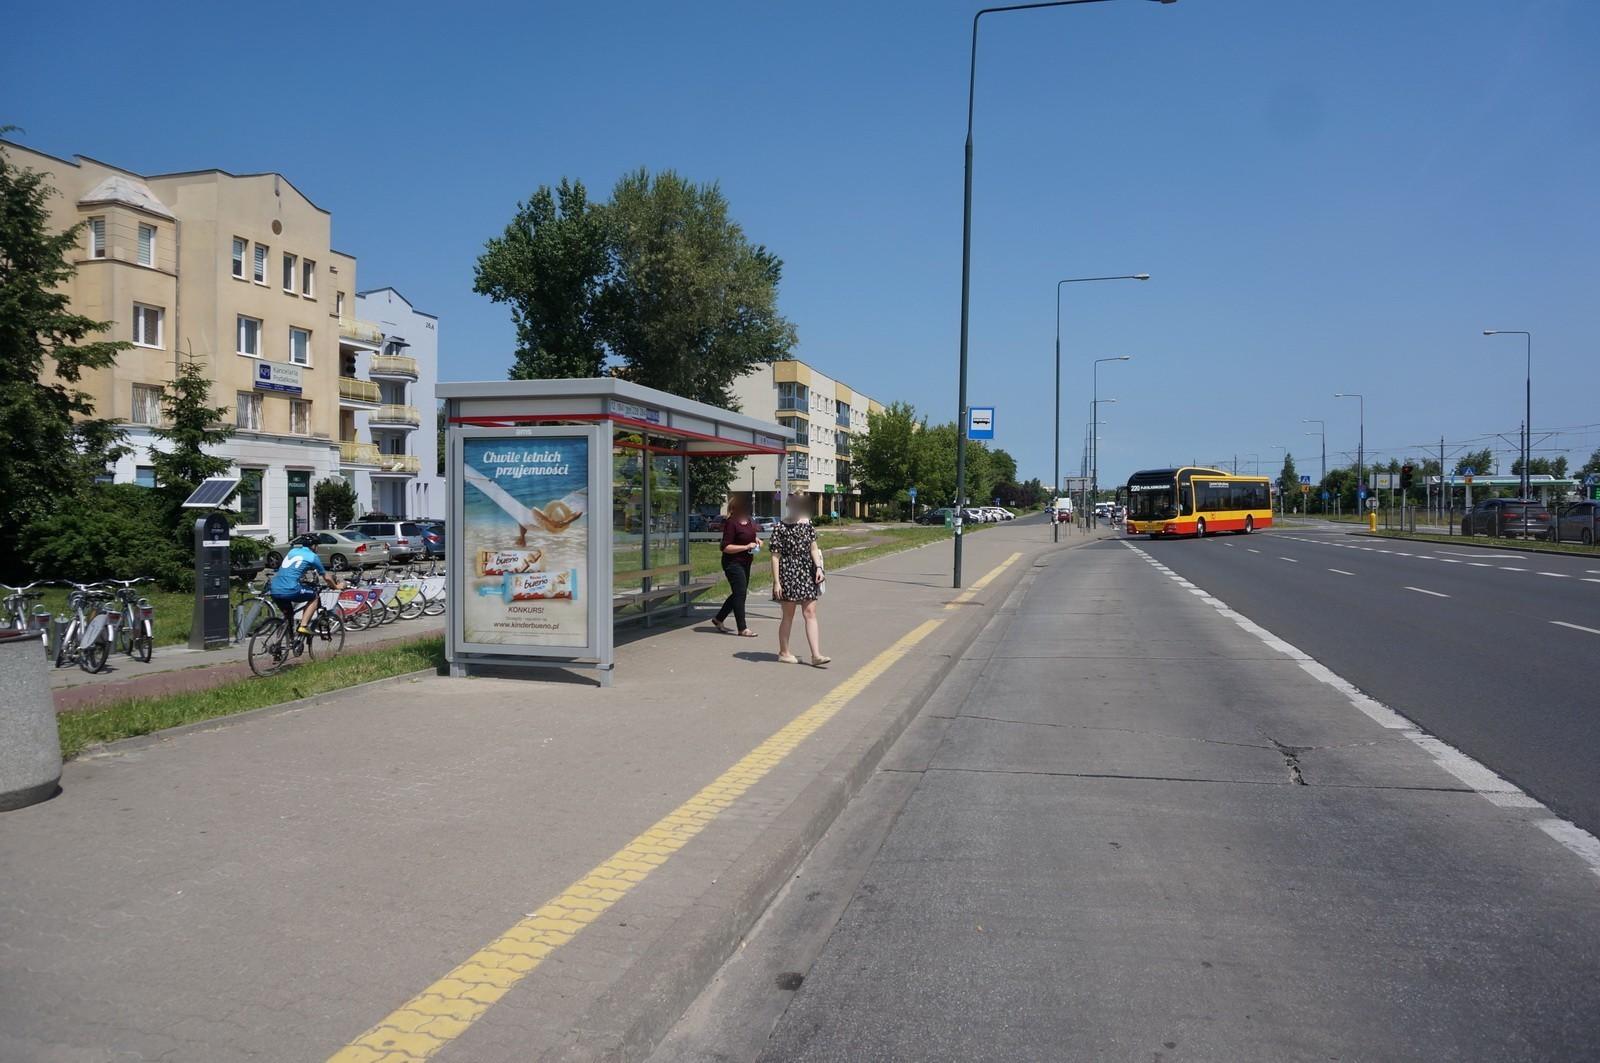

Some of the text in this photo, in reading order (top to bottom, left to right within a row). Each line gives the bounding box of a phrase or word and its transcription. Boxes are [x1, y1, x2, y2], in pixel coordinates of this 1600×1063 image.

[483, 451, 561, 463] Chwile letnich
[495, 464, 569, 478] przyjemności
[496, 555, 519, 565] bueno
[524, 579, 548, 589] bueno
[493, 622, 559, 630] www.kinderbueno.pl
